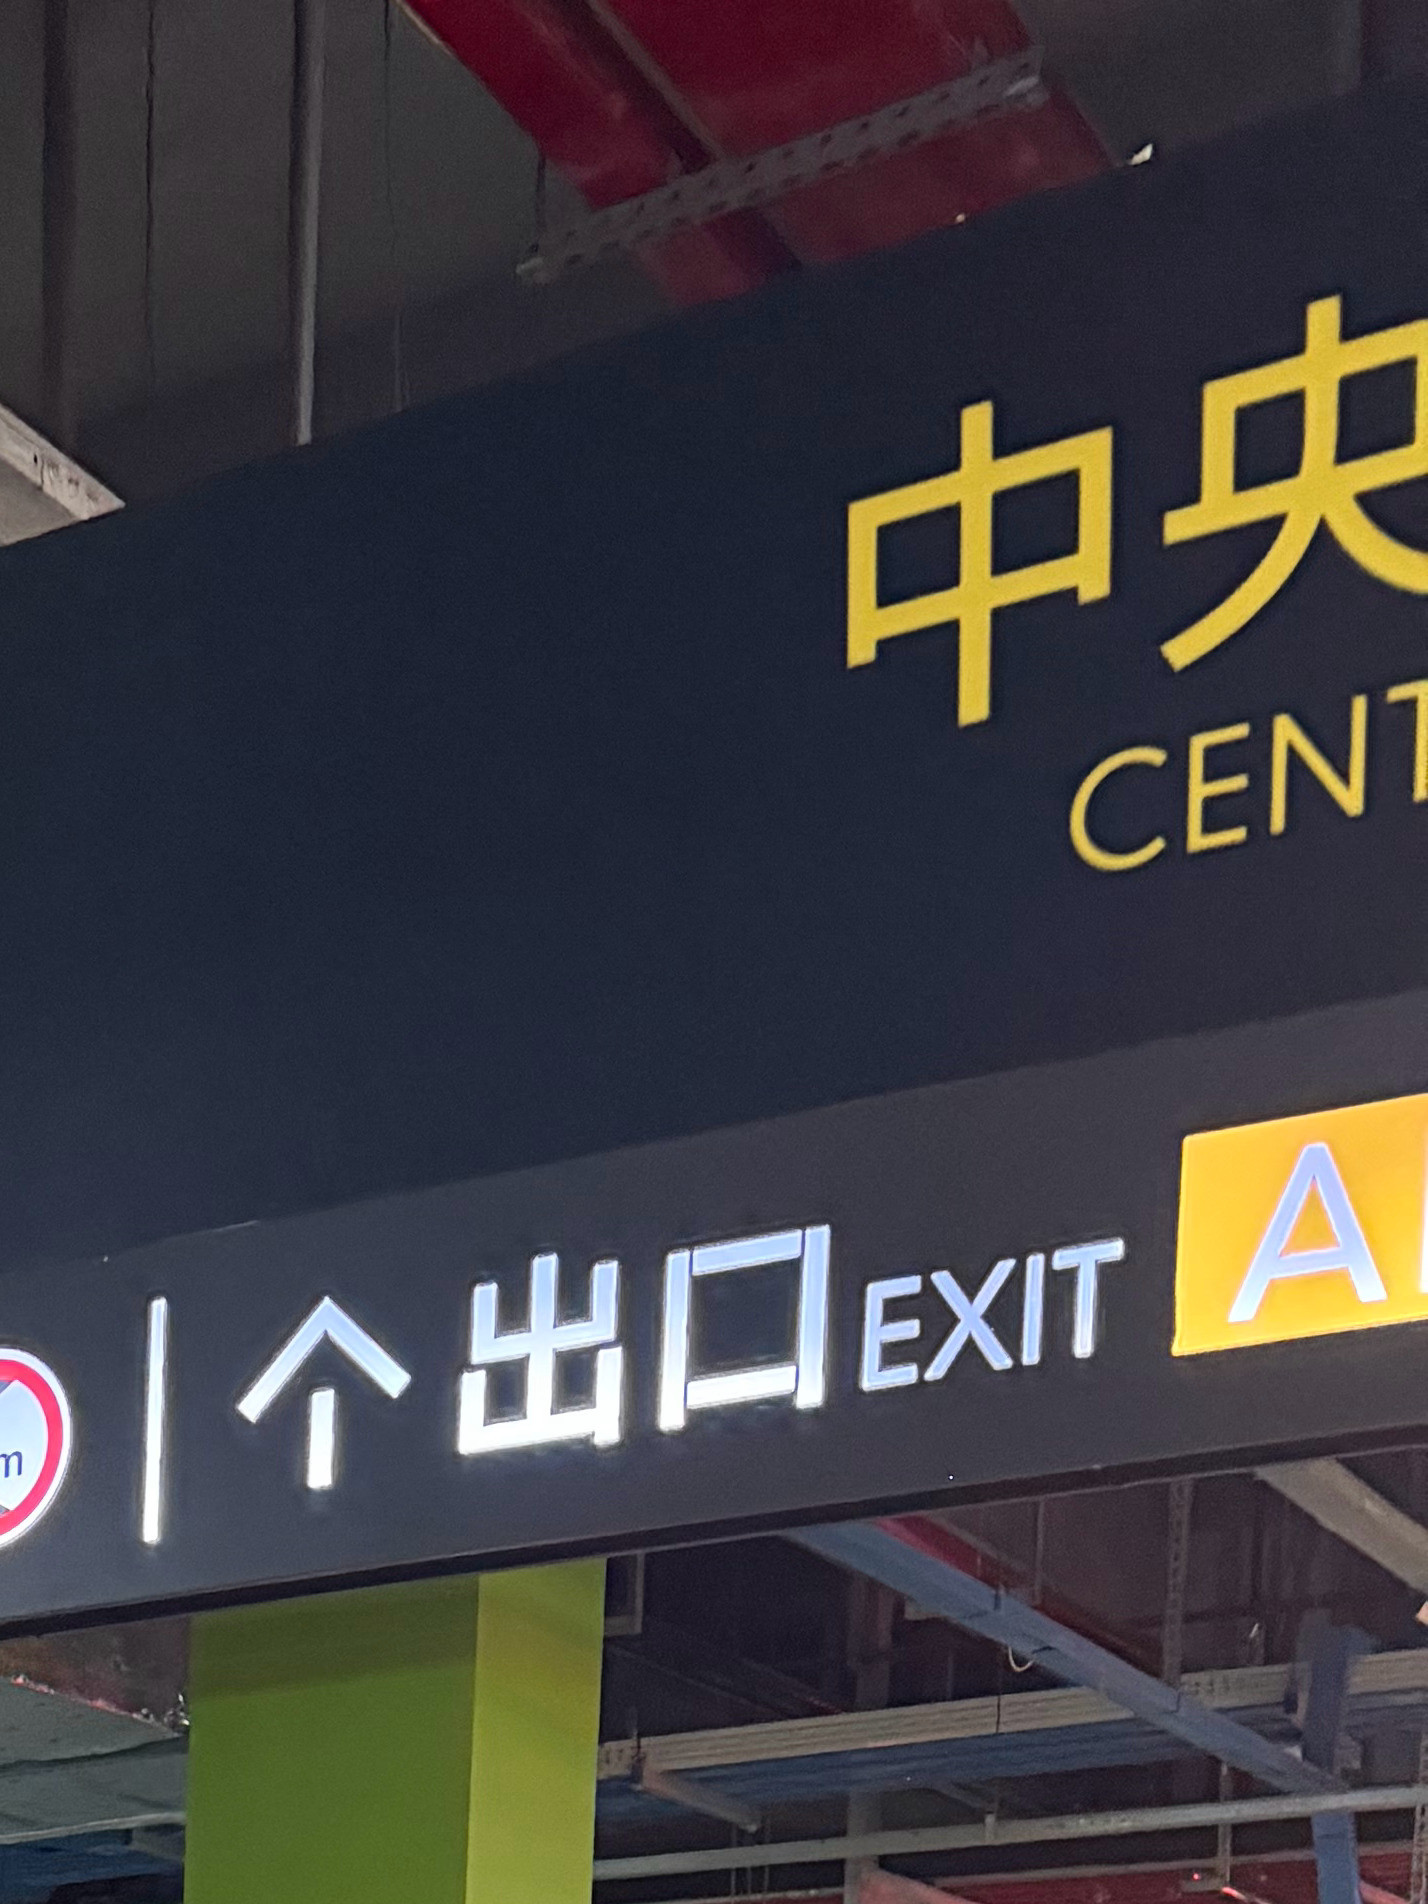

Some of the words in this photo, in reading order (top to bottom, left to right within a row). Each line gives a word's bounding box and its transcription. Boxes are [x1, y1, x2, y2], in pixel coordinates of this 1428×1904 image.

[847, 293, 1428, 729] 中央
[1069, 678, 1428, 873] CENT
[457, 1224, 832, 1455] 出口
[858, 1237, 1126, 1392] EXIT
[1227, 1135, 1428, 1324] A
